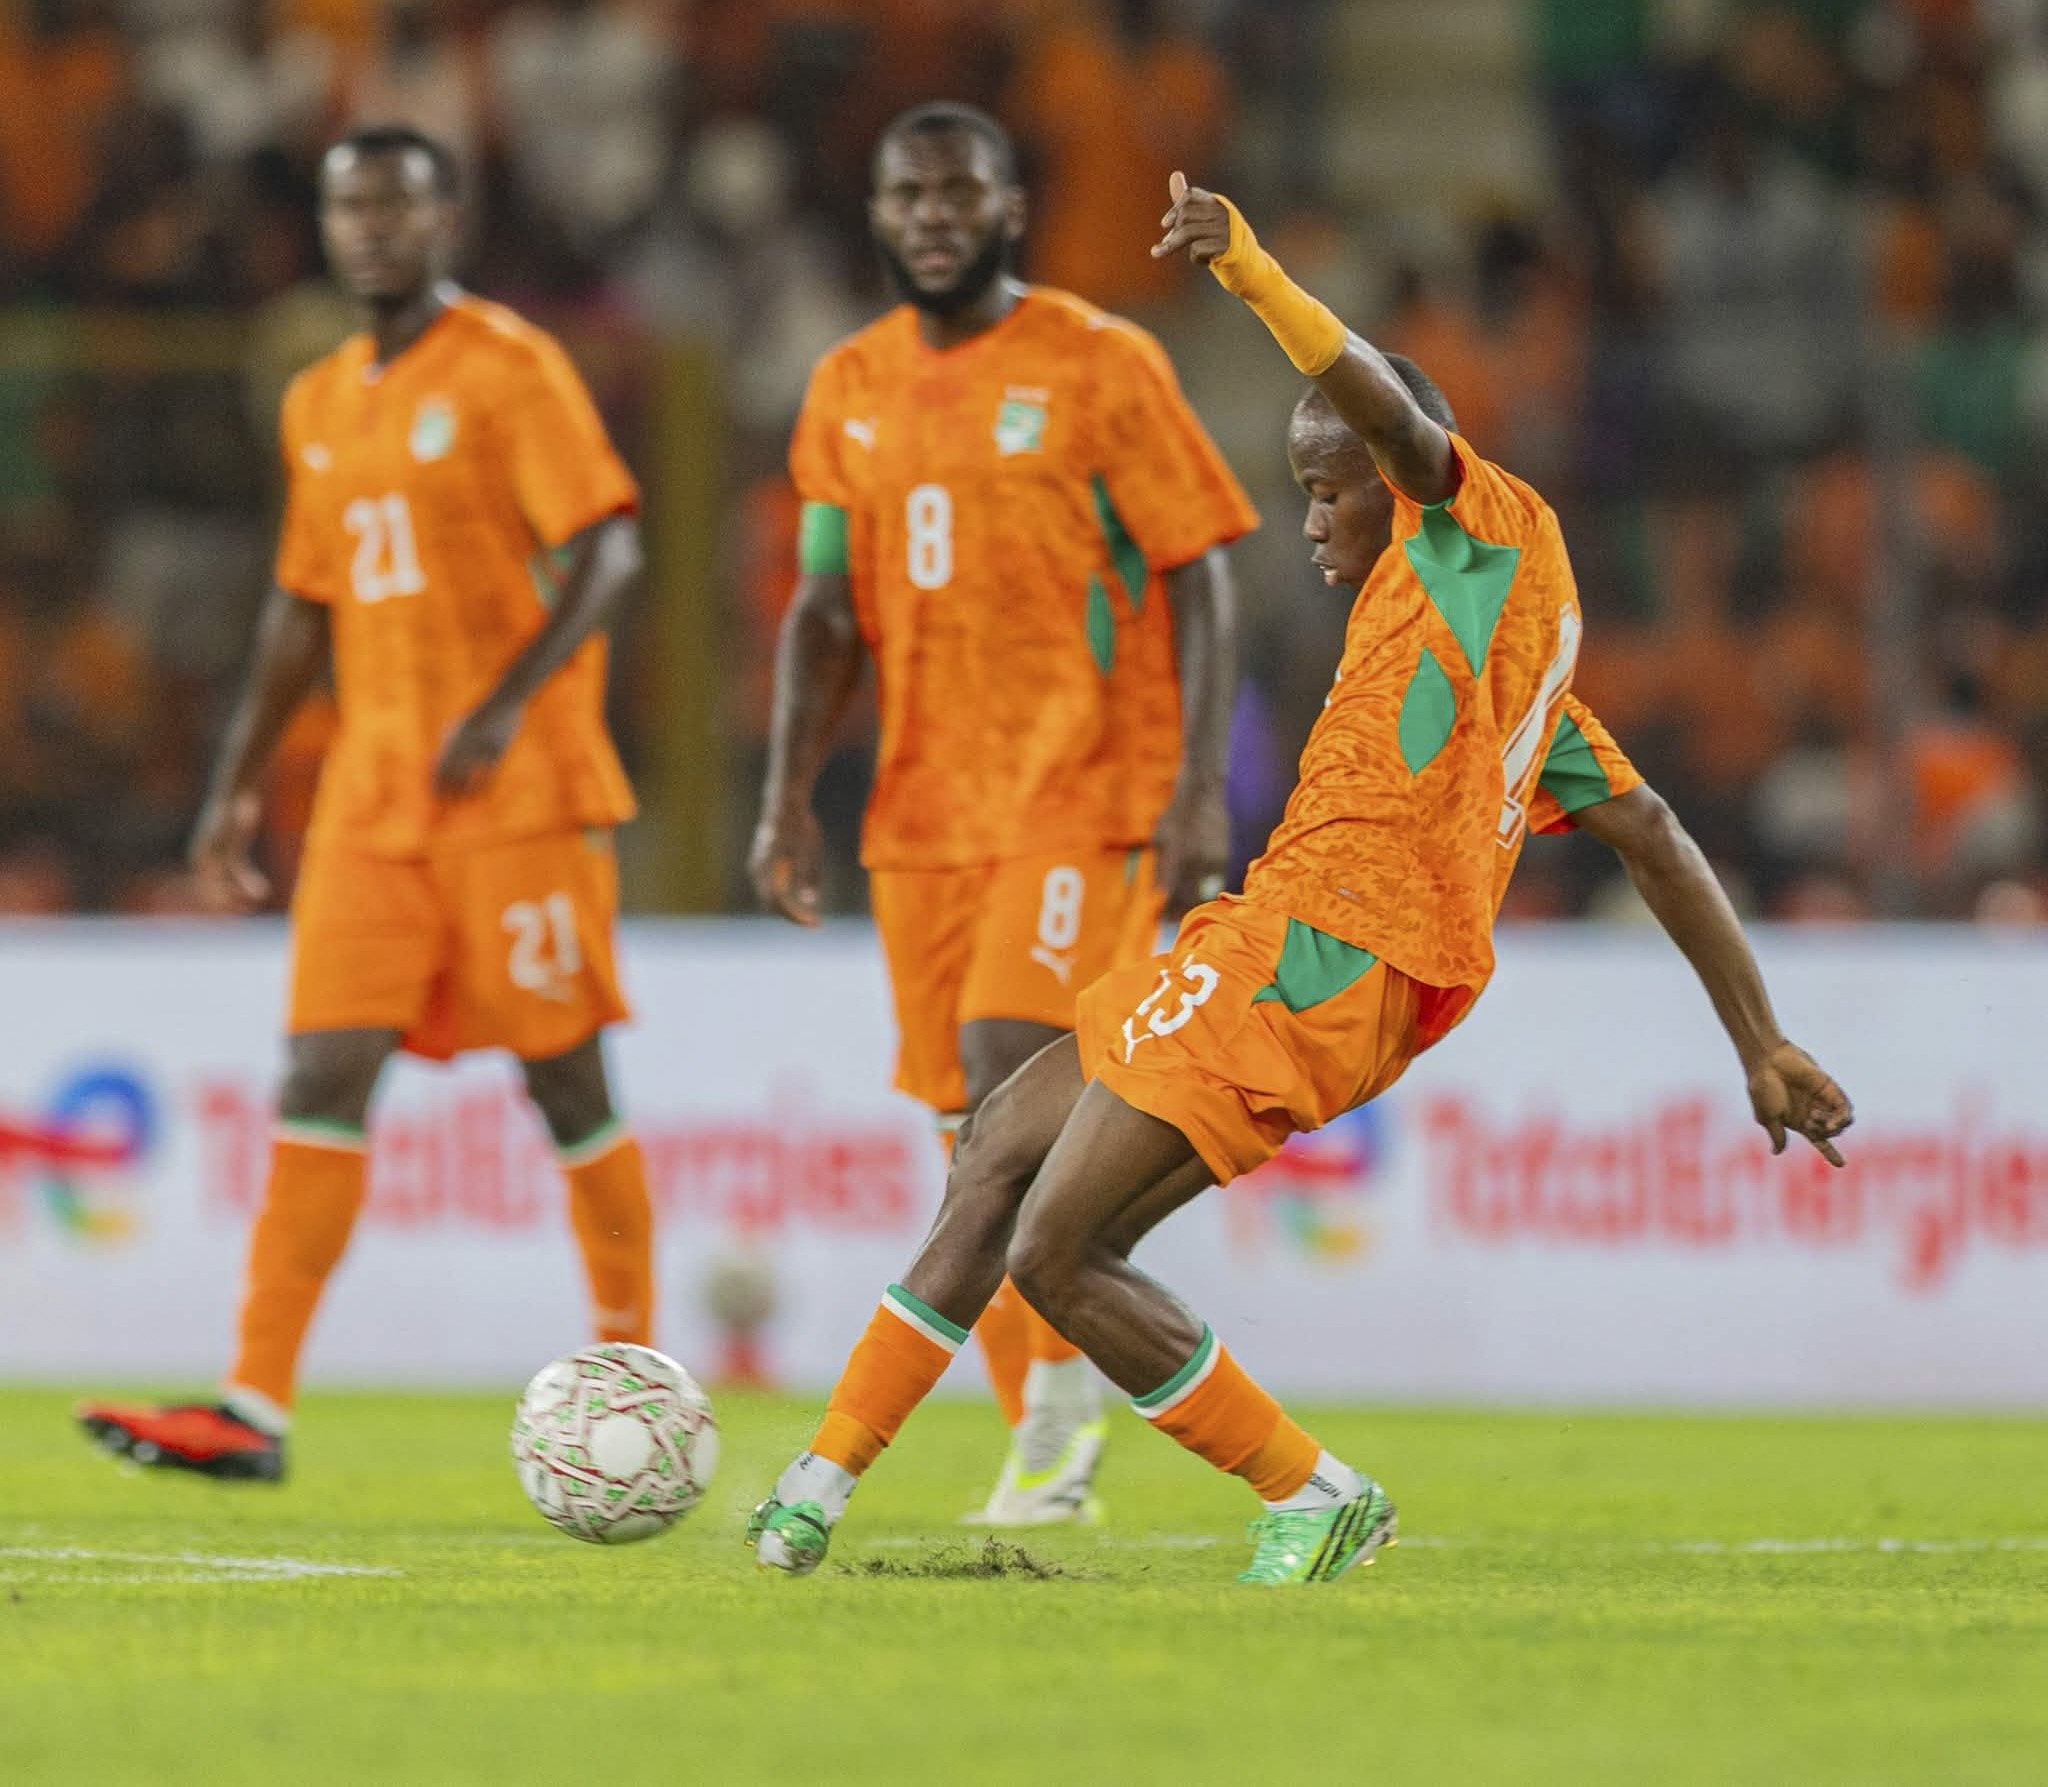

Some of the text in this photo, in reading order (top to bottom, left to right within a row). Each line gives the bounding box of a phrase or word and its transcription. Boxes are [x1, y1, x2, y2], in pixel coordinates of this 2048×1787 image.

[344, 493, 428, 603] 21
[906, 483, 953, 589] 8
[501, 893, 582, 989] 21
[1039, 865, 1084, 947] 8
